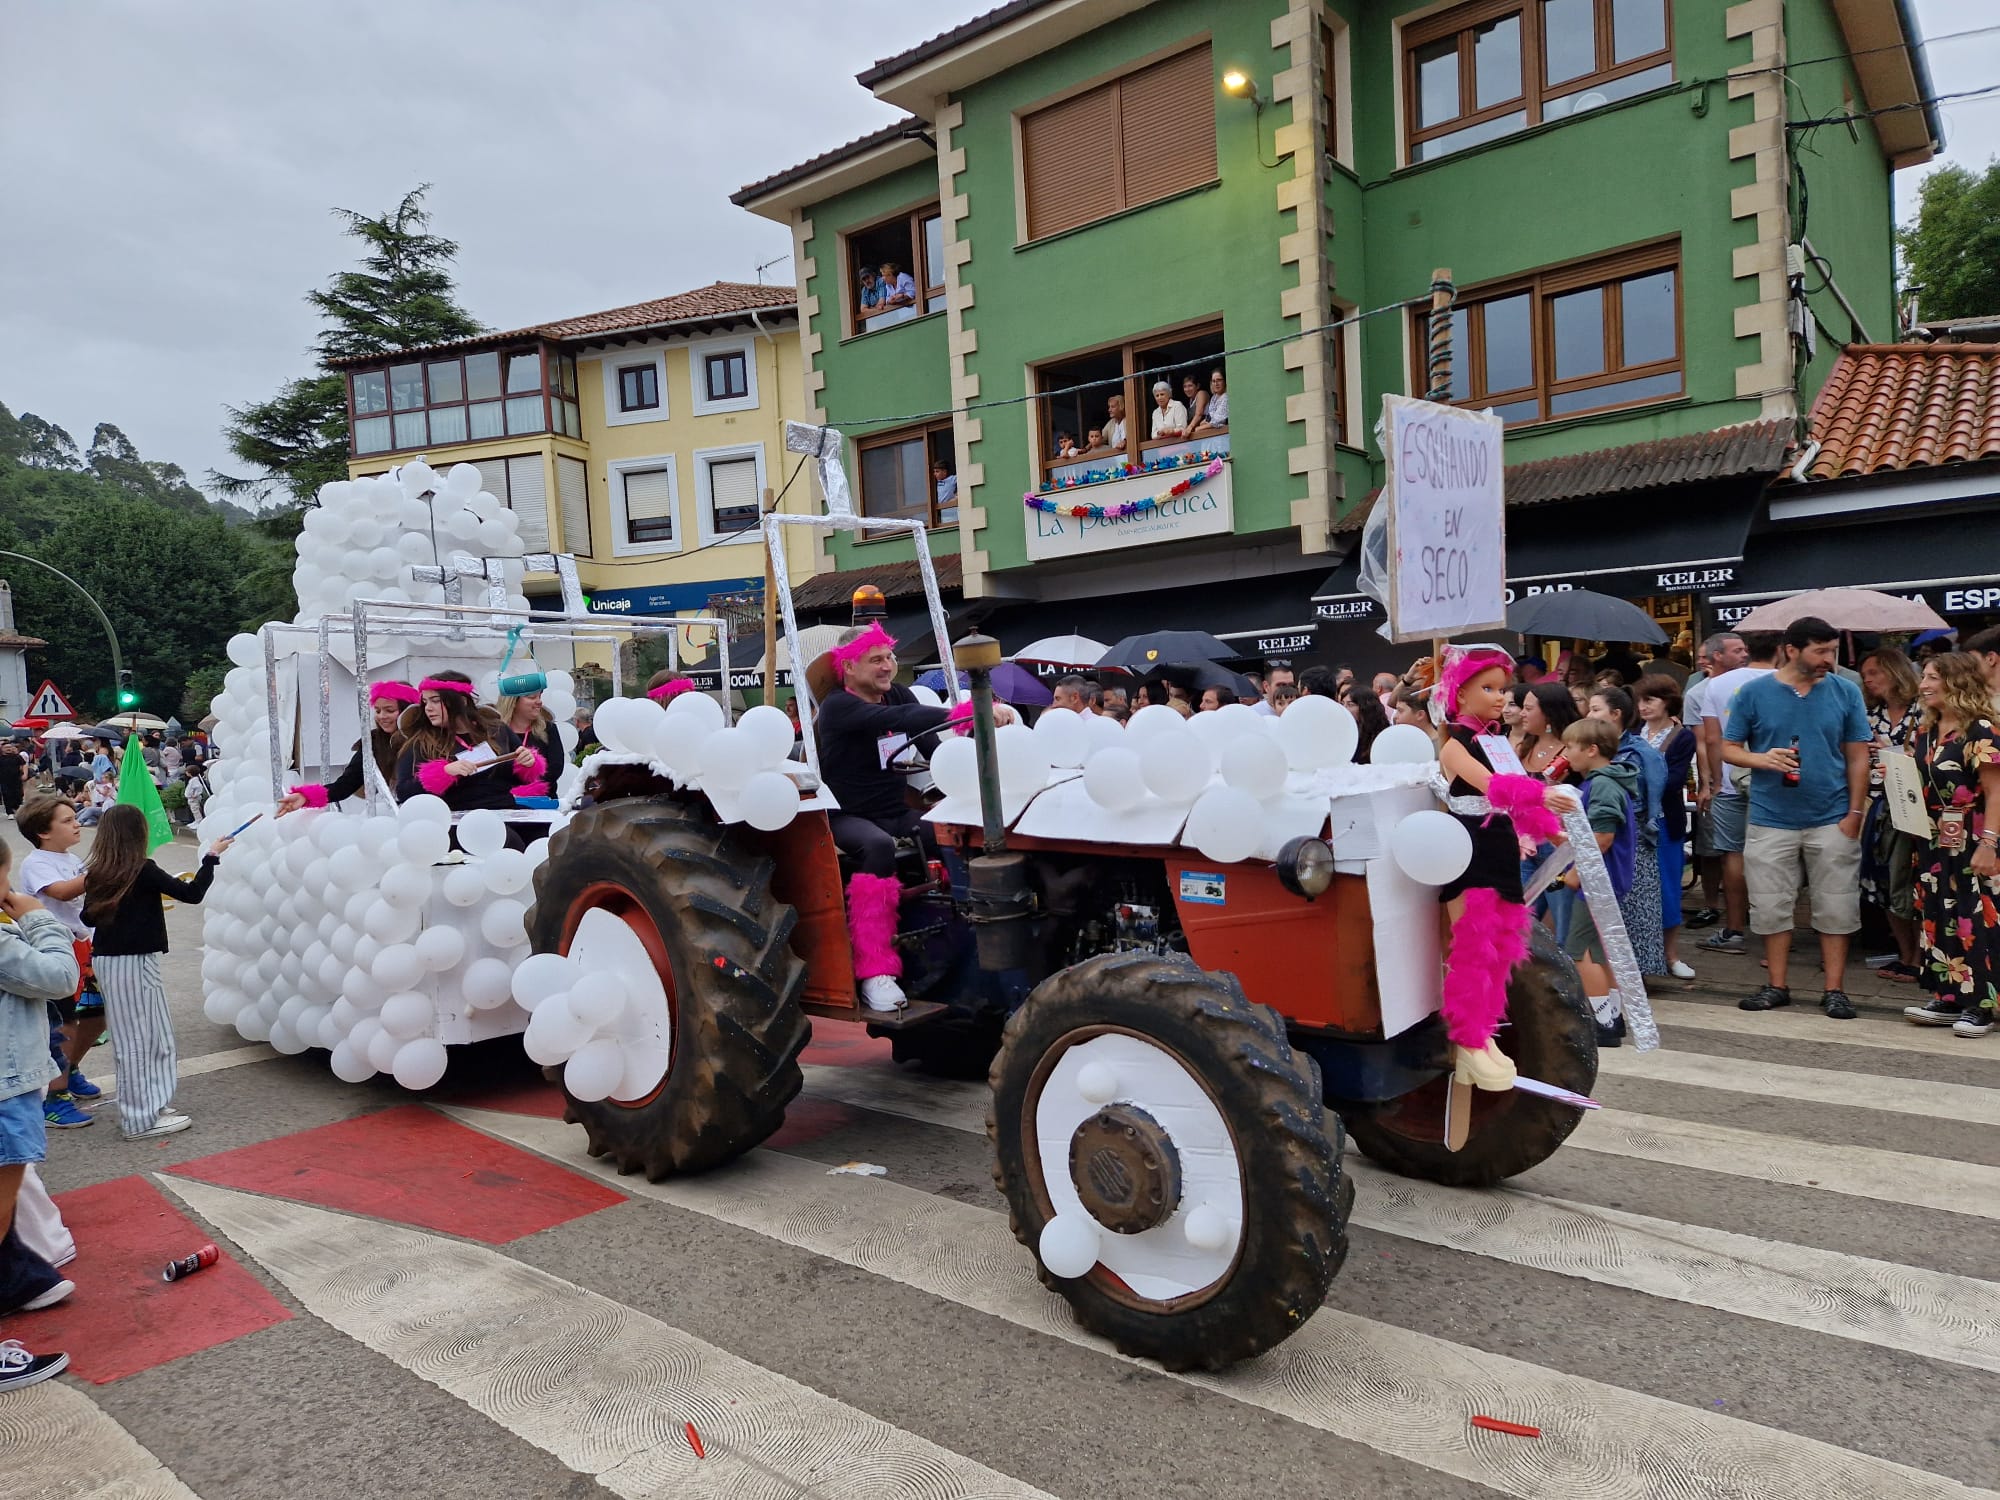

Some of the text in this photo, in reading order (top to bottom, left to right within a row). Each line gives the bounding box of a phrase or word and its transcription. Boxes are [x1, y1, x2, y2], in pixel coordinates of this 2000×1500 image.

[1037, 507, 1065, 537] La
[1444, 506, 1464, 538] EN
[1421, 545, 1469, 605] SECO
[1656, 568, 1734, 587] KELER
[592, 598, 631, 612] Unicaja
[1316, 601, 1373, 615] KELER
[1945, 587, 2000, 611] ESP
[1257, 635, 1312, 650] KELER
[730, 674, 762, 687] OCINA
